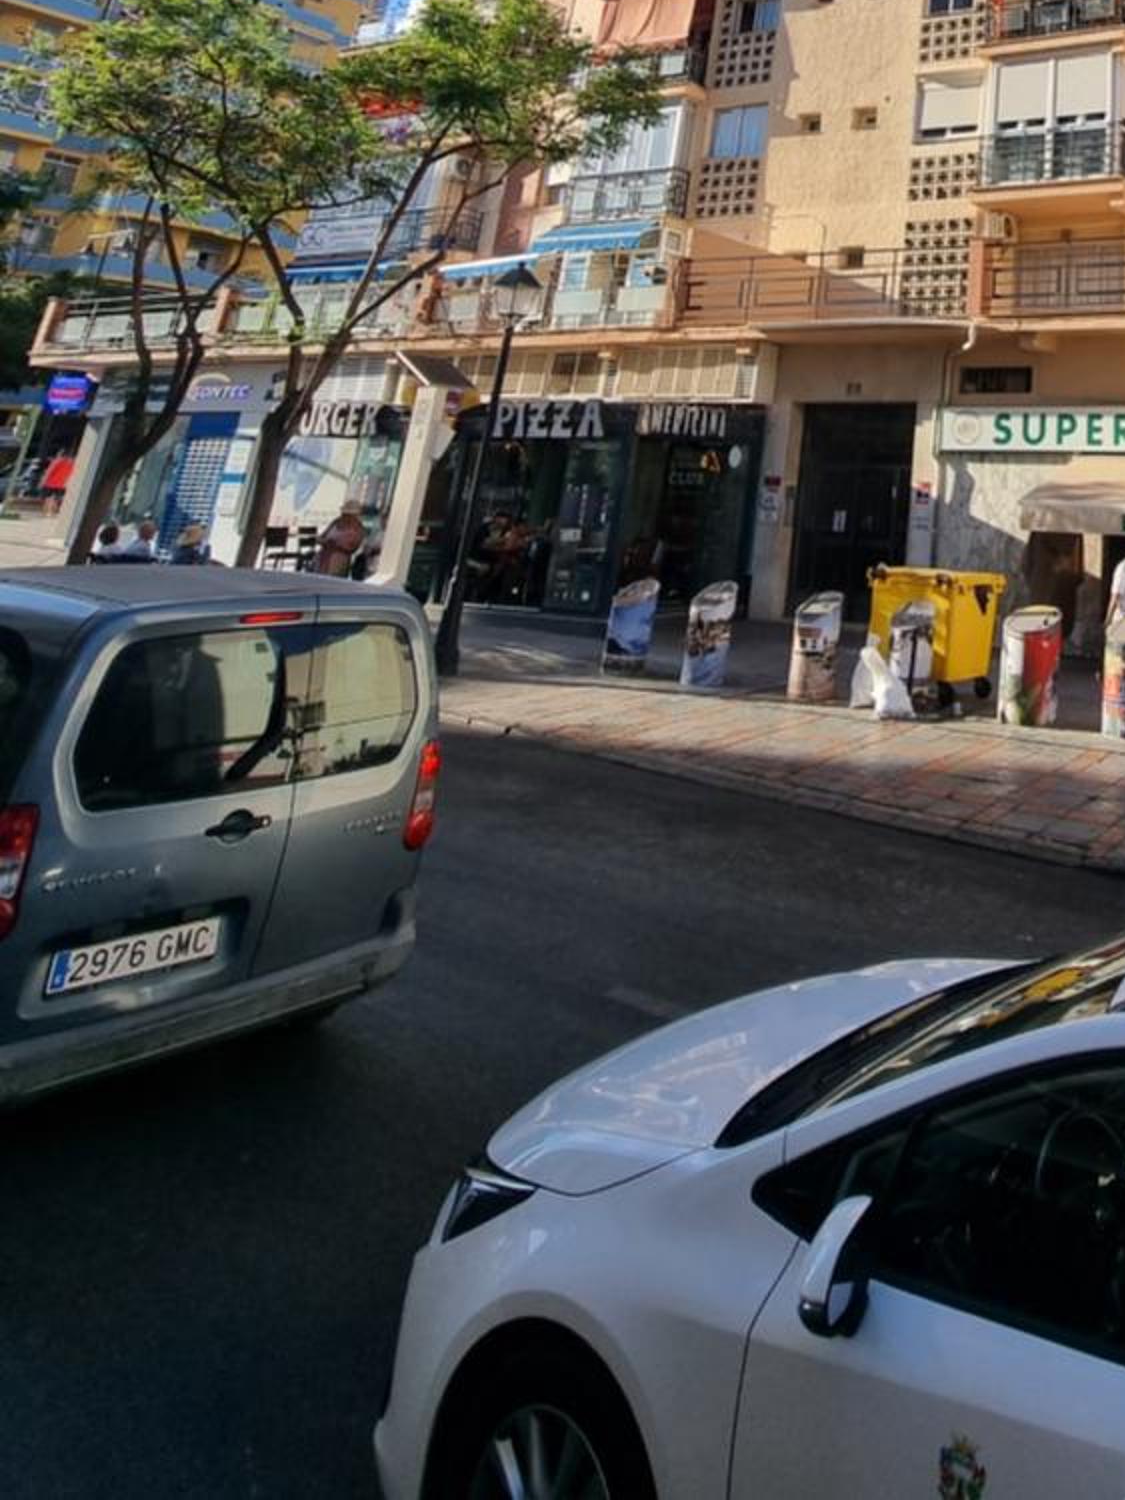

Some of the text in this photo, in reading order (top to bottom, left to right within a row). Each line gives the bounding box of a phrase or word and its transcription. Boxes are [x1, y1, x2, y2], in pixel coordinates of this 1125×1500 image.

[300, 403, 378, 436] URGER
[492, 402, 605, 438] PIZZA
[68, 926, 210, 984] 2976 GMC
